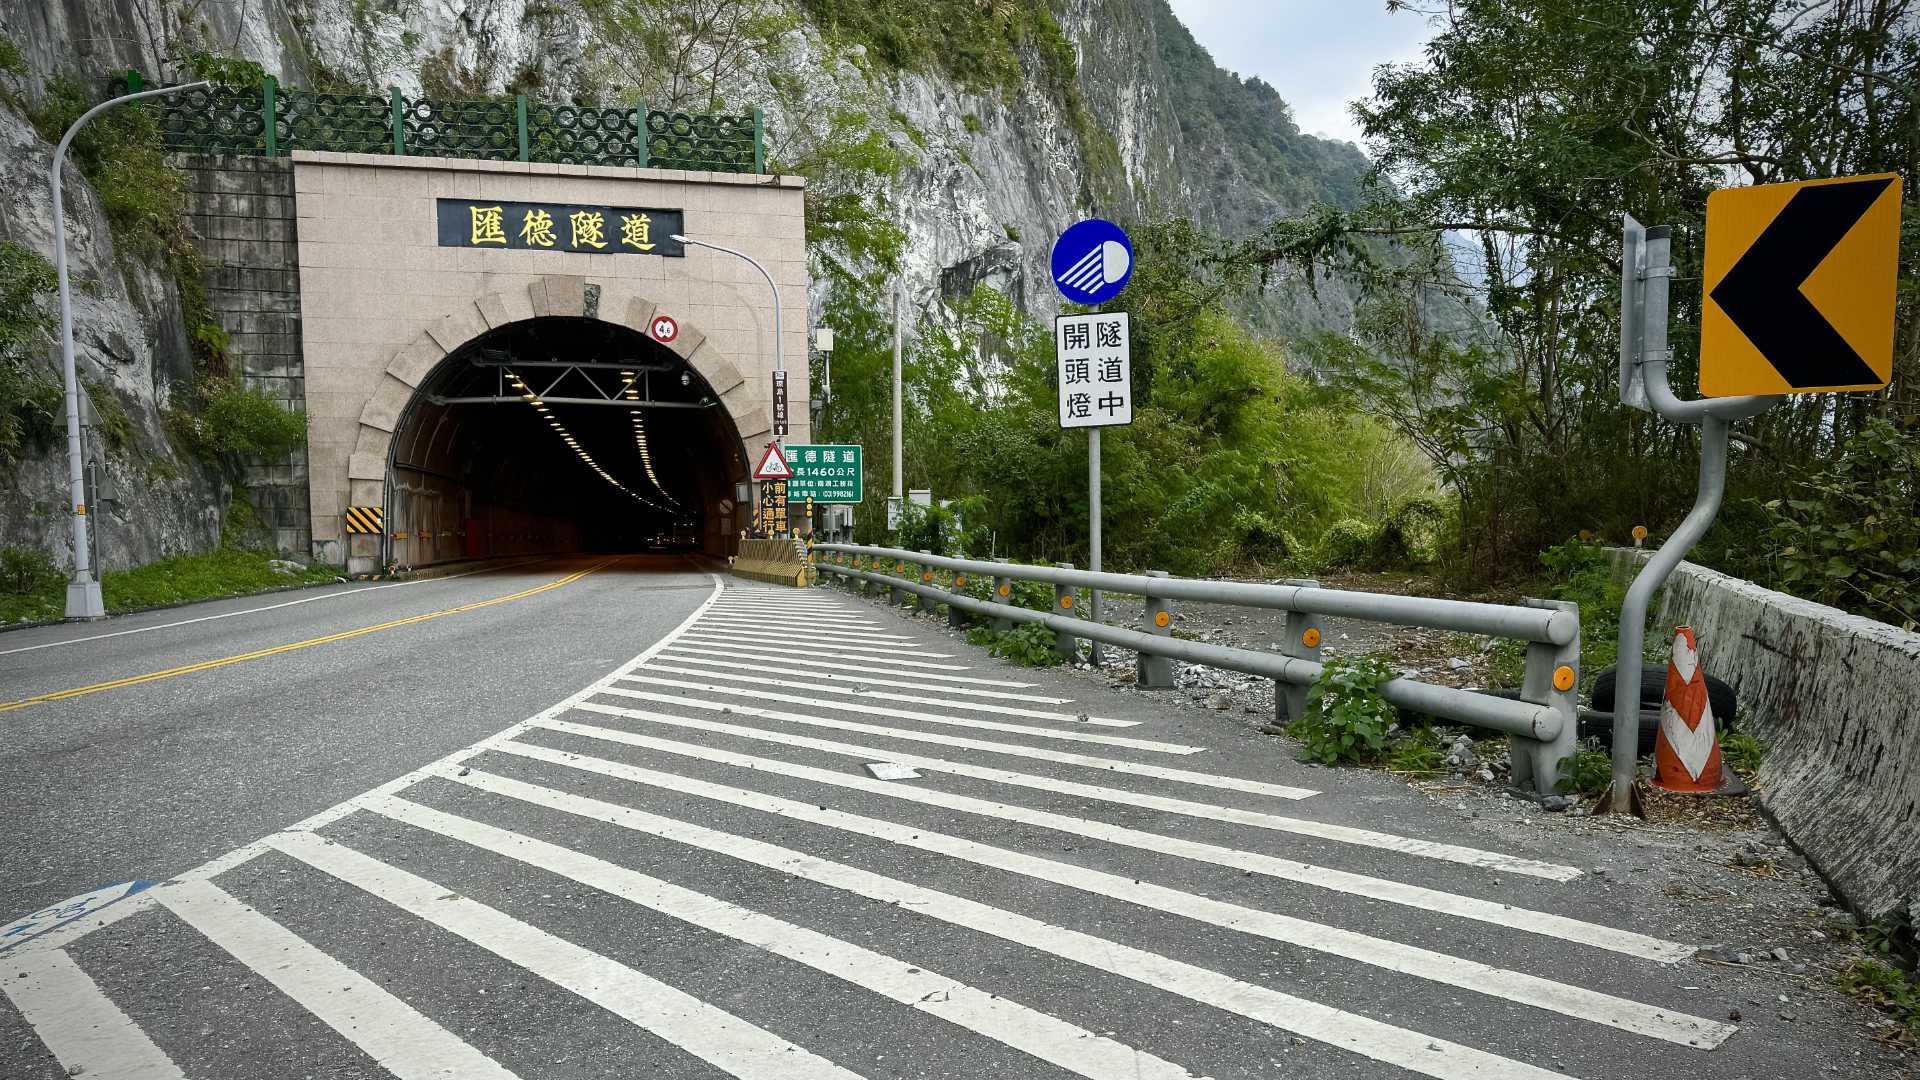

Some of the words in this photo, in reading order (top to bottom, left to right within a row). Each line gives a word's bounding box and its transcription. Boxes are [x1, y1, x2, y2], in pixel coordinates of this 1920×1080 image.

[469, 205, 656, 251] 匯德隧道
[659, 324, 671, 334] 4.6
[1063, 322, 1092, 419] 開頭燈
[1096, 320, 1124, 417] 隧道中
[785, 449, 855, 463] 匯德隧道
[790, 467, 855, 476] 長1460公尺
[762, 482, 775, 533] 小心通行
[774, 482, 787, 532] 前有單車
